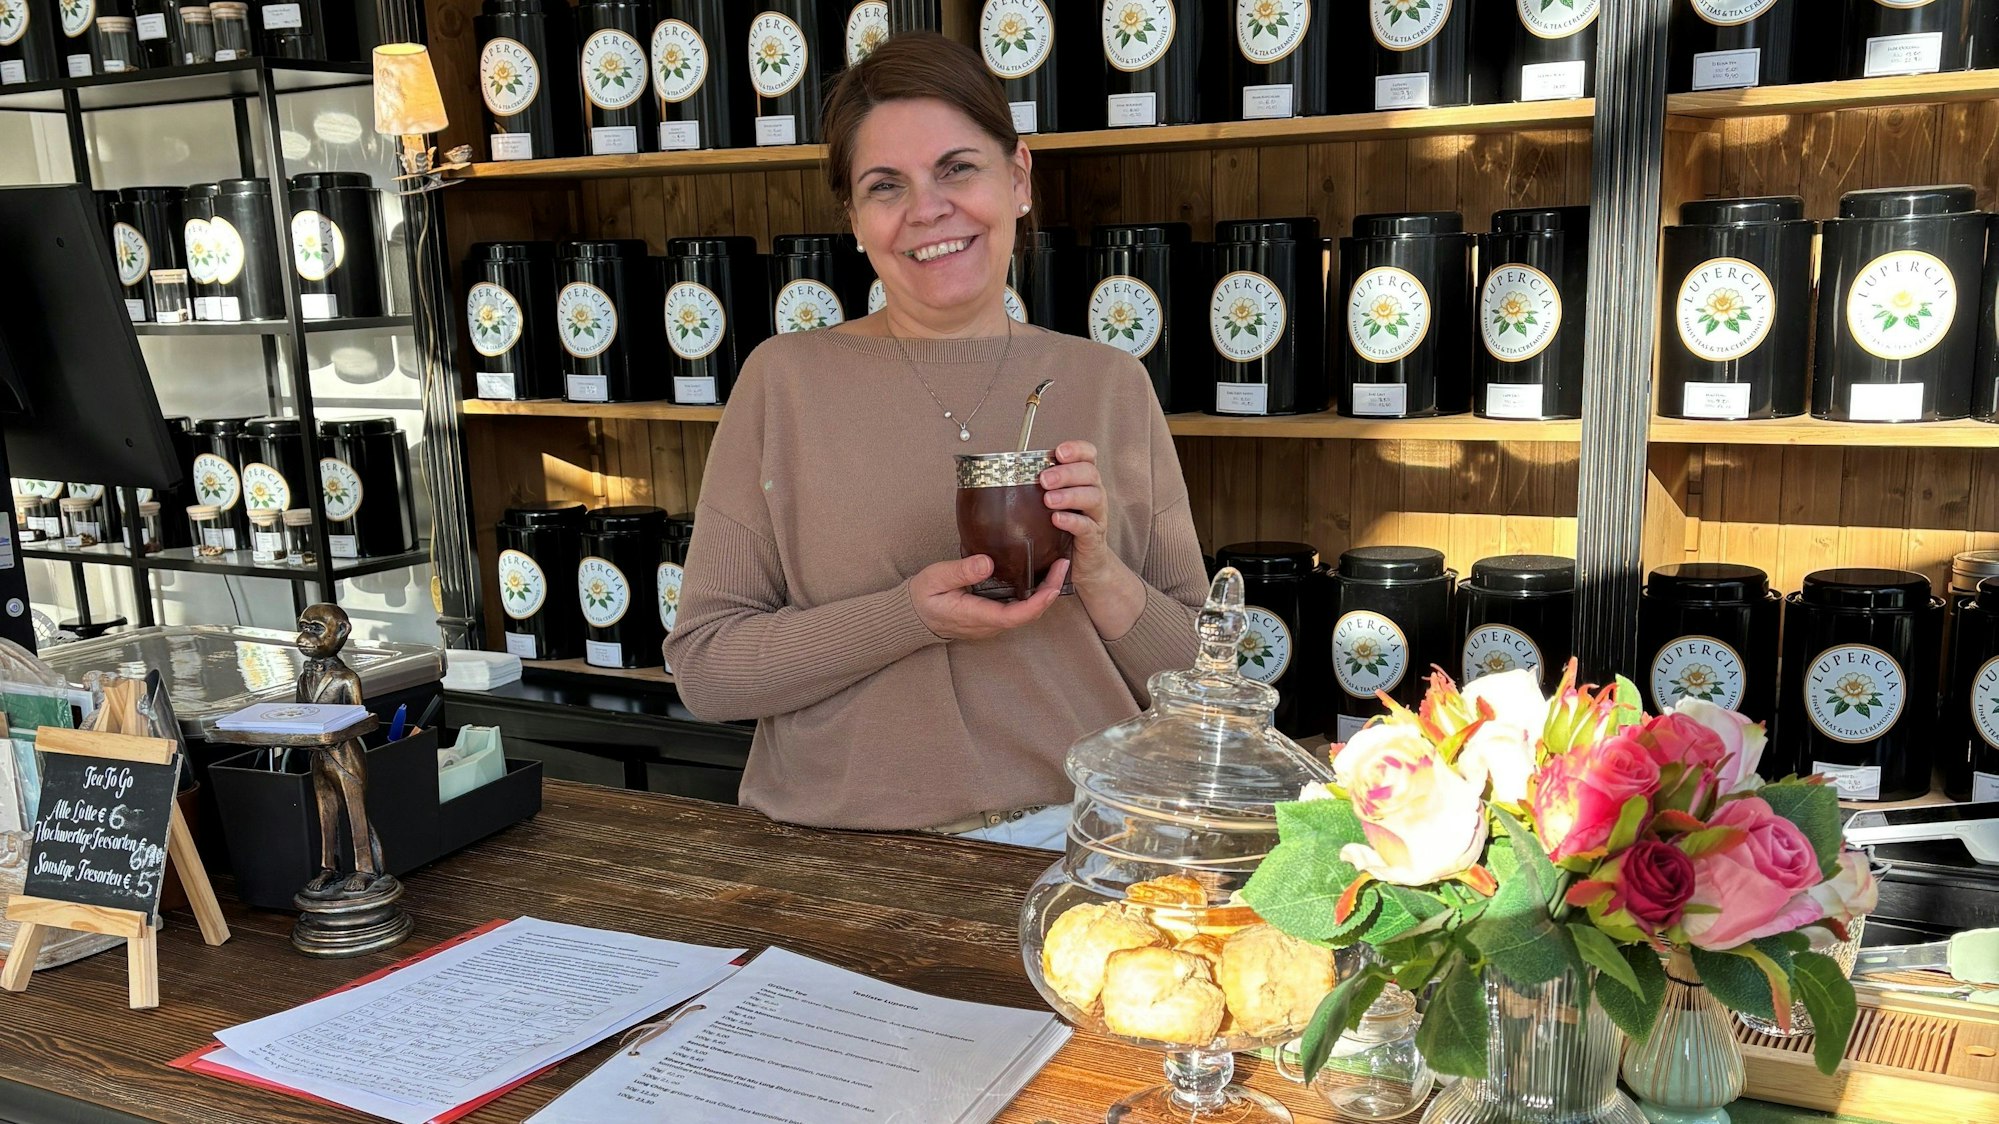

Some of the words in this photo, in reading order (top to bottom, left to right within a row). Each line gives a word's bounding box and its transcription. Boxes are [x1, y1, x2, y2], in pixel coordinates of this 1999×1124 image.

[750, 18, 801, 53] LUPERCIA
[848, 7, 888, 40] LUPERC
[1270, 22, 1301, 54] CEREMONIES
[1412, 3, 1443, 40] CEREMONIES
[482, 44, 532, 73] LUPERCIA
[585, 36, 642, 65] LUPERCIA
[1022, 35, 1047, 68] CEREMONIES
[1142, 26, 1168, 60] CEREMONIES
[779, 285, 838, 315] LUPERCIA
[1092, 283, 1155, 315] LUPERCIA
[1214, 279, 1278, 312] LUPERCIA
[1353, 275, 1422, 311] LUPERCIA
[1484, 271, 1552, 309] LUPERCIA
[1684, 267, 1766, 303] LUPERCIA
[560, 288, 611, 317] LUPERCIA
[667, 288, 718, 316] LUPERCIA
[1390, 322, 1421, 353] CEREMONIES
[1518, 321, 1550, 352] CEREMONIES
[1252, 613, 1284, 643] RCIA
[1336, 619, 1401, 652] LUPERCIA
[1466, 630, 1537, 670] LUPERCIA
[1658, 644, 1738, 679] LUPERCIA
[1812, 652, 1899, 691] LUPERCIA
[1812, 694, 1824, 718] FINEST
[1822, 717, 1837, 731] TEAS
[1859, 703, 1896, 735] CEREMONIES
[1978, 704, 1990, 728] FINEST
[83, 766, 102, 789] Tea
[103, 767, 117, 790] To
[115, 767, 134, 799] Go
[46, 799, 70, 821] Alle
[98, 808, 107, 823] €
[109, 804, 127, 830] 6
[35, 820, 92, 853] Hochwertige
[90, 827, 136, 852] Teesorten
[34, 852, 75, 882] Sonstige
[75, 859, 122, 886] Teesorten
[123, 874, 132, 889] €
[852, 990, 883, 1002] Teeliste
[884, 999, 919, 1011] Lupercia
